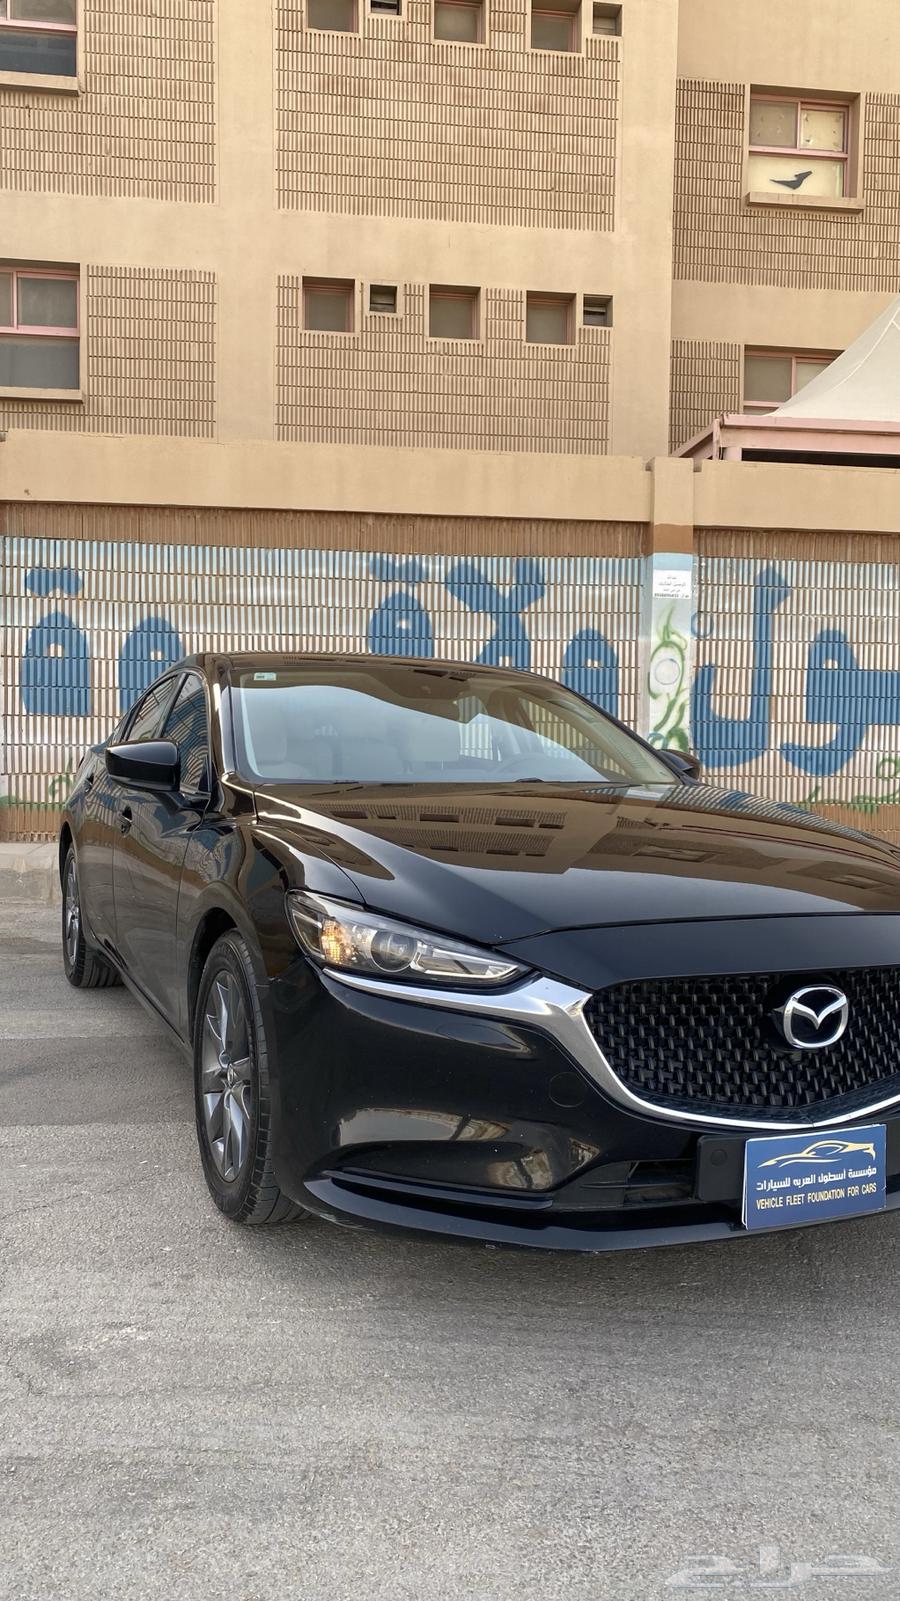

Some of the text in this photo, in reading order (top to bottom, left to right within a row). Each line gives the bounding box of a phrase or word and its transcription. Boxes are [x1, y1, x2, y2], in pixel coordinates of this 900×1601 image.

[848, 1165, 877, 1178] مؤسسة
[756, 1177, 791, 1192] للسيارات
[756, 1182, 877, 1210] VEHICLE FLEET FOUNDATION FOR CARS
